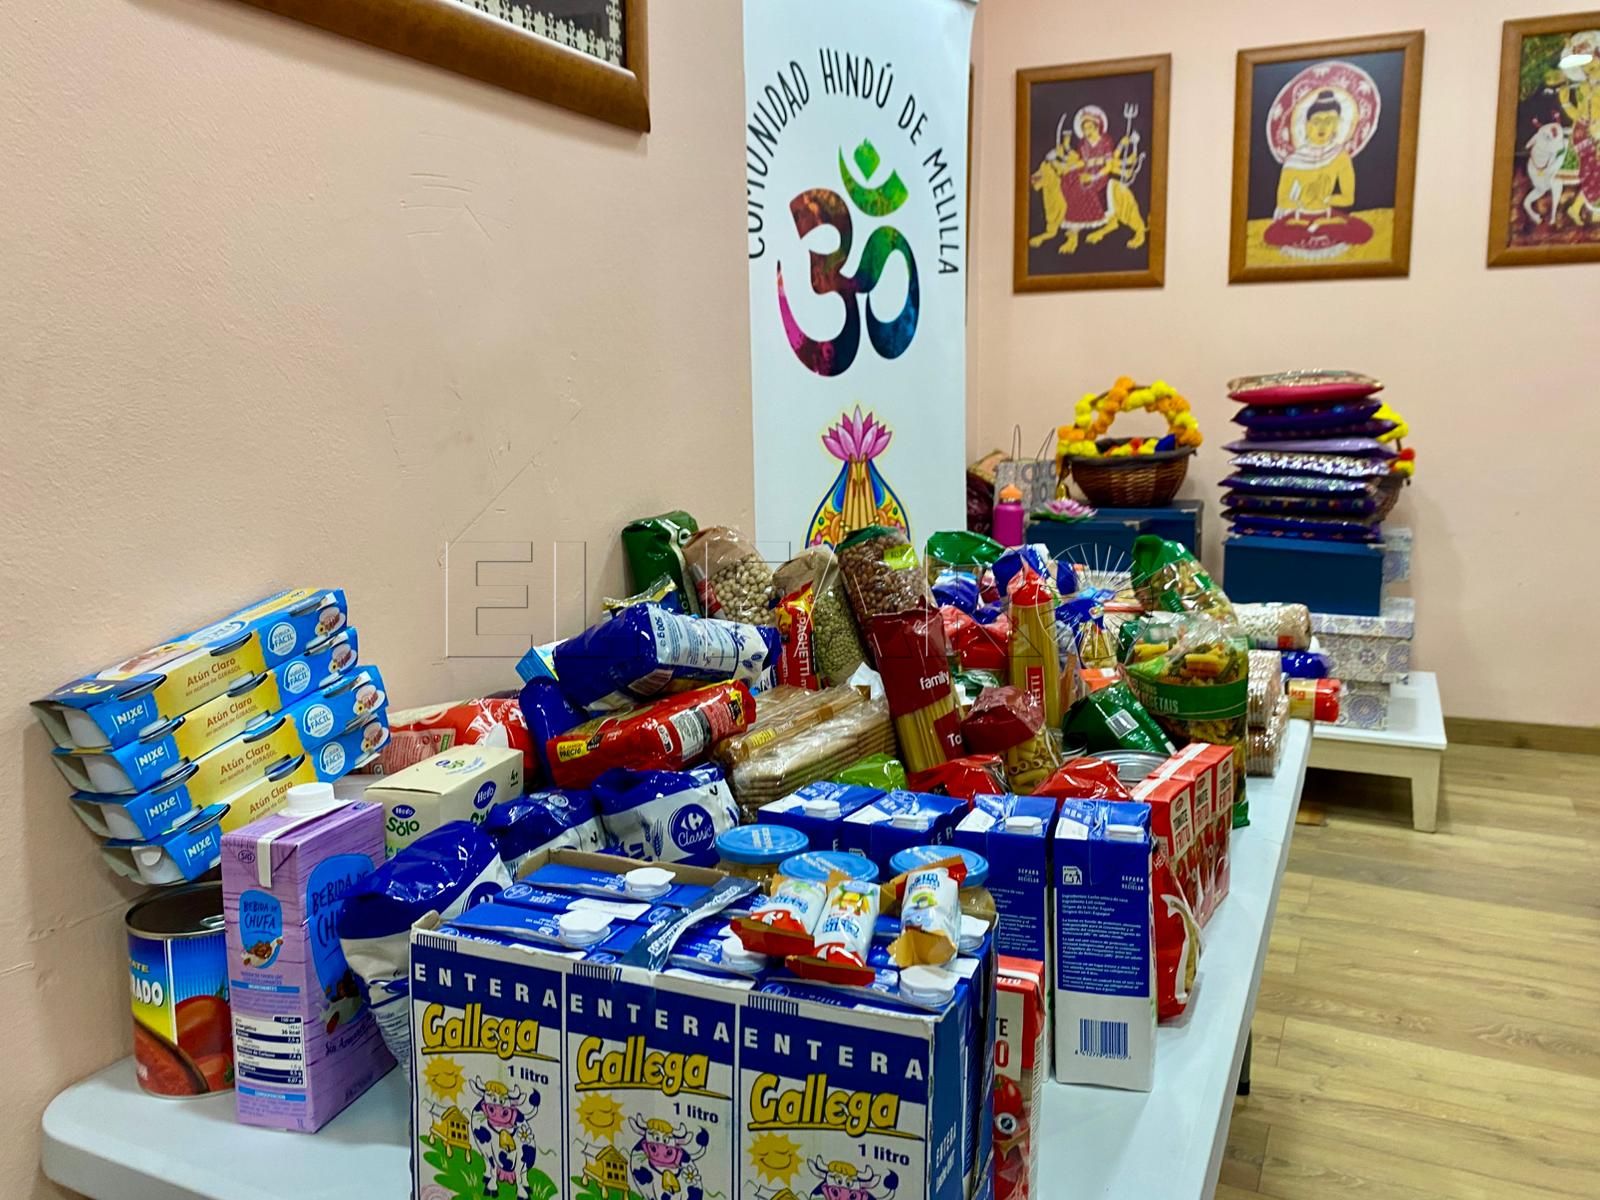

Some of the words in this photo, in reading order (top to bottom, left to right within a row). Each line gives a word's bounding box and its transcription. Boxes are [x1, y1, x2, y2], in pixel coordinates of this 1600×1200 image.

[820, 48, 893, 109] HINDÚ
[898, 94, 928, 145] DE
[923, 148, 959, 274] MELILLA
[187, 670, 210, 687] Atún
[211, 657, 236, 673] Claro
[920, 670, 950, 691] family
[206, 710, 229, 727] Atún
[230, 697, 253, 713] Claro
[220, 757, 245, 775] Atún
[245, 743, 271, 760] Claro
[249, 795, 271, 813] Atún
[243, 901, 270, 913] BEBIDA
[312, 874, 351, 916] BEBIDA
[244, 912, 276, 930] CHUFA
[415, 962, 558, 1009] ENTERA
[422, 1002, 541, 1059] Gallega
[570, 993, 730, 1044] ENTERA
[576, 1035, 710, 1097] Gallega
[744, 1027, 924, 1081] ENTERA
[508, 1065, 515, 1077] 1
[520, 1067, 549, 1086] litro
[673, 1102, 681, 1117] 1
[687, 1103, 719, 1123] litro
[749, 1072, 900, 1138] Gallega
[858, 1144, 867, 1157] 1
[874, 1146, 910, 1166] litro
